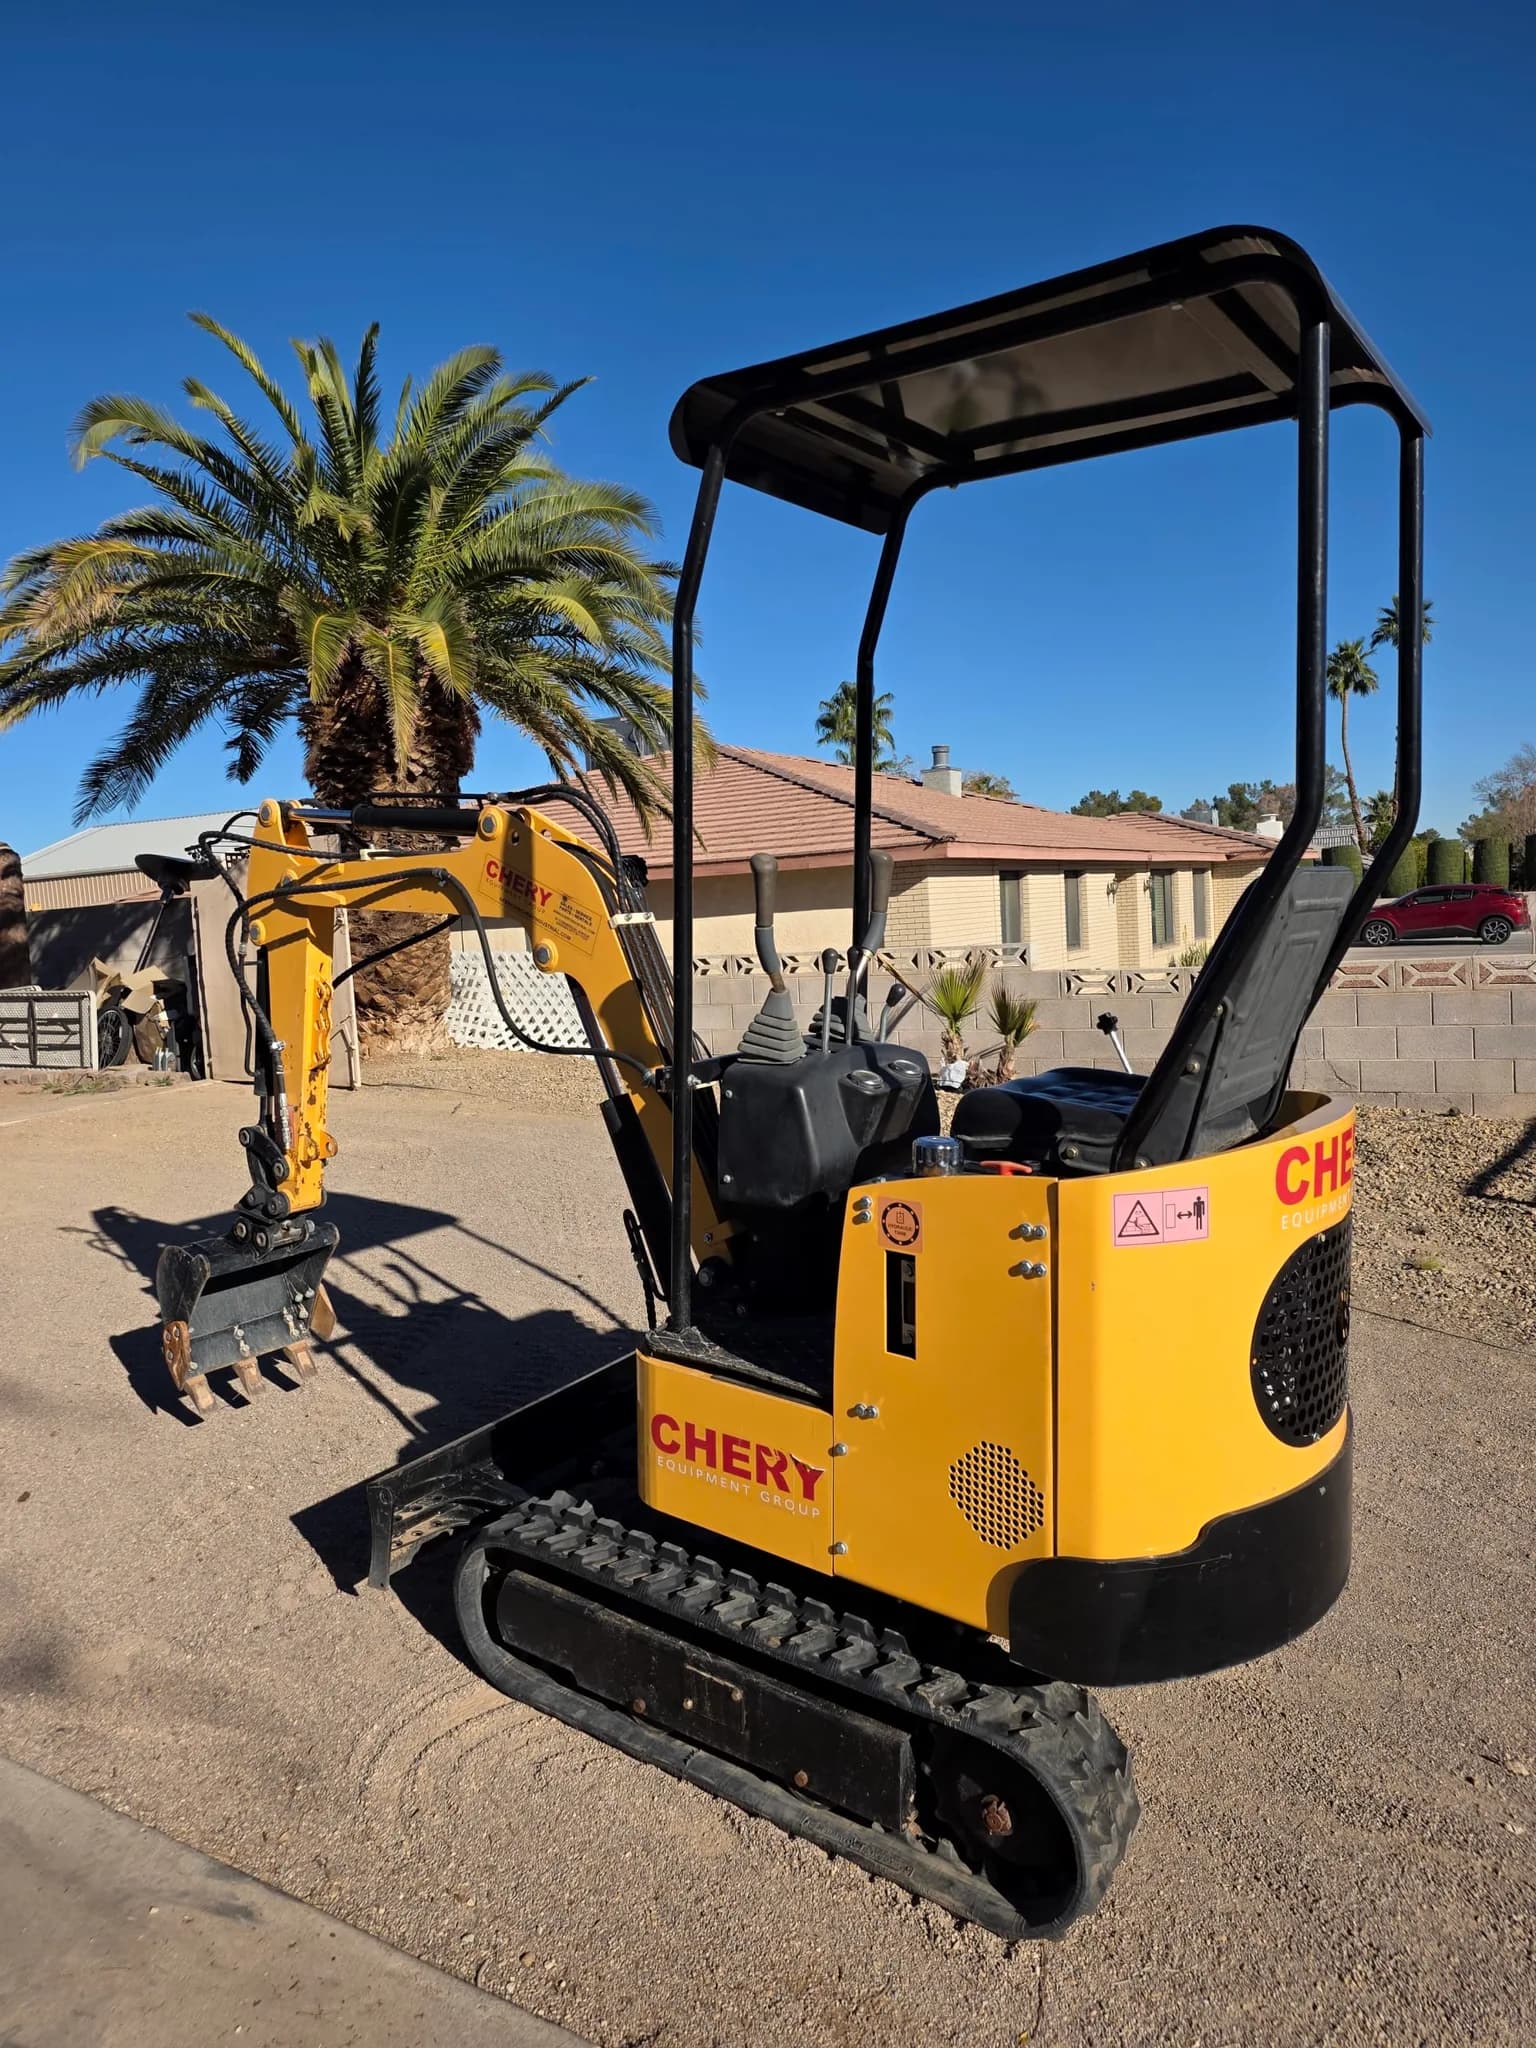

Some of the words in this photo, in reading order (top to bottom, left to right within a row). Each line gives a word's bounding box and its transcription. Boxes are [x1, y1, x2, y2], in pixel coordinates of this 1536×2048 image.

[486, 860, 552, 907] CHERY
[1275, 1124, 1355, 1206] CHE
[651, 1413, 825, 1501] CHERY
[657, 1455, 750, 1496] EQUIPMENT
[760, 1490, 821, 1519] GROUP
